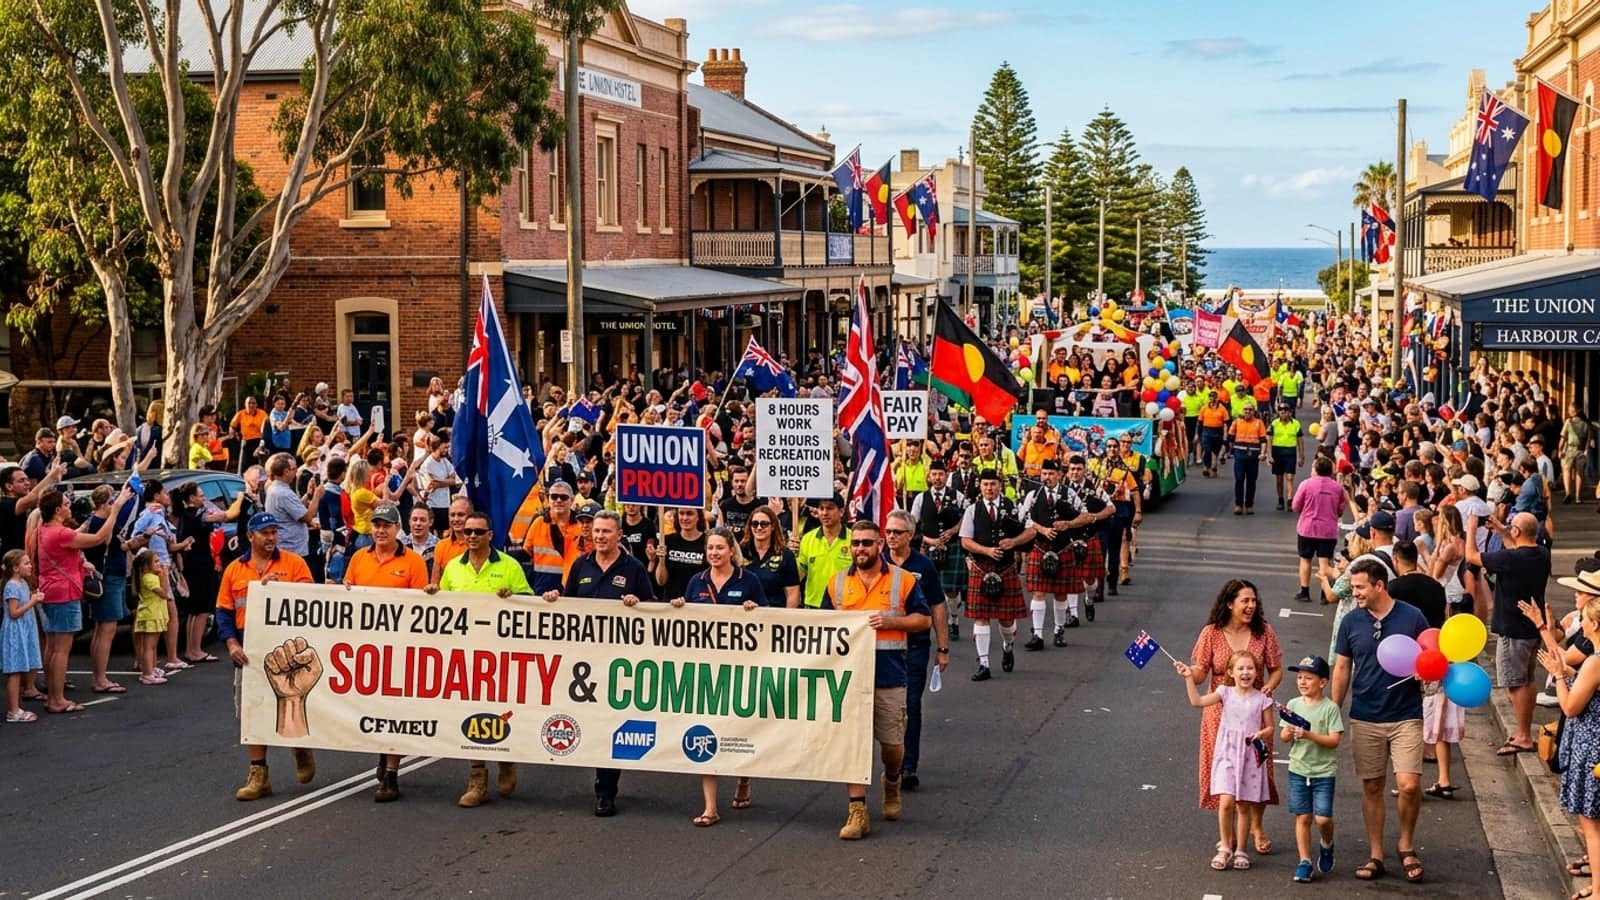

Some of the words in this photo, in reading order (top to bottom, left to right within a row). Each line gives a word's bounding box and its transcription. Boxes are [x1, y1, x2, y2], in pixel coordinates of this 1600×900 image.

[1492, 298, 1530, 314] THE
[1534, 298, 1596, 314] UNION
[600, 321, 617, 330] THE
[618, 321, 646, 330] UNION
[1496, 329, 1579, 343] HARBOUR
[768, 403, 776, 416] 8
[779, 403, 820, 416] HOURS
[883, 396, 922, 413] FAIR
[776, 418, 812, 430] WORK
[887, 416, 919, 433] PAY
[768, 434, 776, 447] 8
[779, 434, 820, 447] HOURS
[622, 433, 699, 467] UNION
[758, 449, 831, 461] RECREATION
[768, 465, 776, 478] 8
[779, 465, 820, 478] HOURS
[622, 469, 699, 500] PROUD
[779, 480, 809, 491] REST
[264, 598, 353, 630] LABOUR
[360, 602, 404, 632] DAY
[410, 605, 468, 635] 2024
[497, 609, 645, 646] CELEBRATING
[771, 624, 850, 656] RIGHTS
[328, 642, 562, 706] SOLIDARITY
[568, 661, 597, 703] &
[607, 658, 853, 723] COMMUNITY
[360, 716, 438, 737] CFMEU
[467, 717, 505, 740] ASU
[614, 731, 655, 747] ANMF
